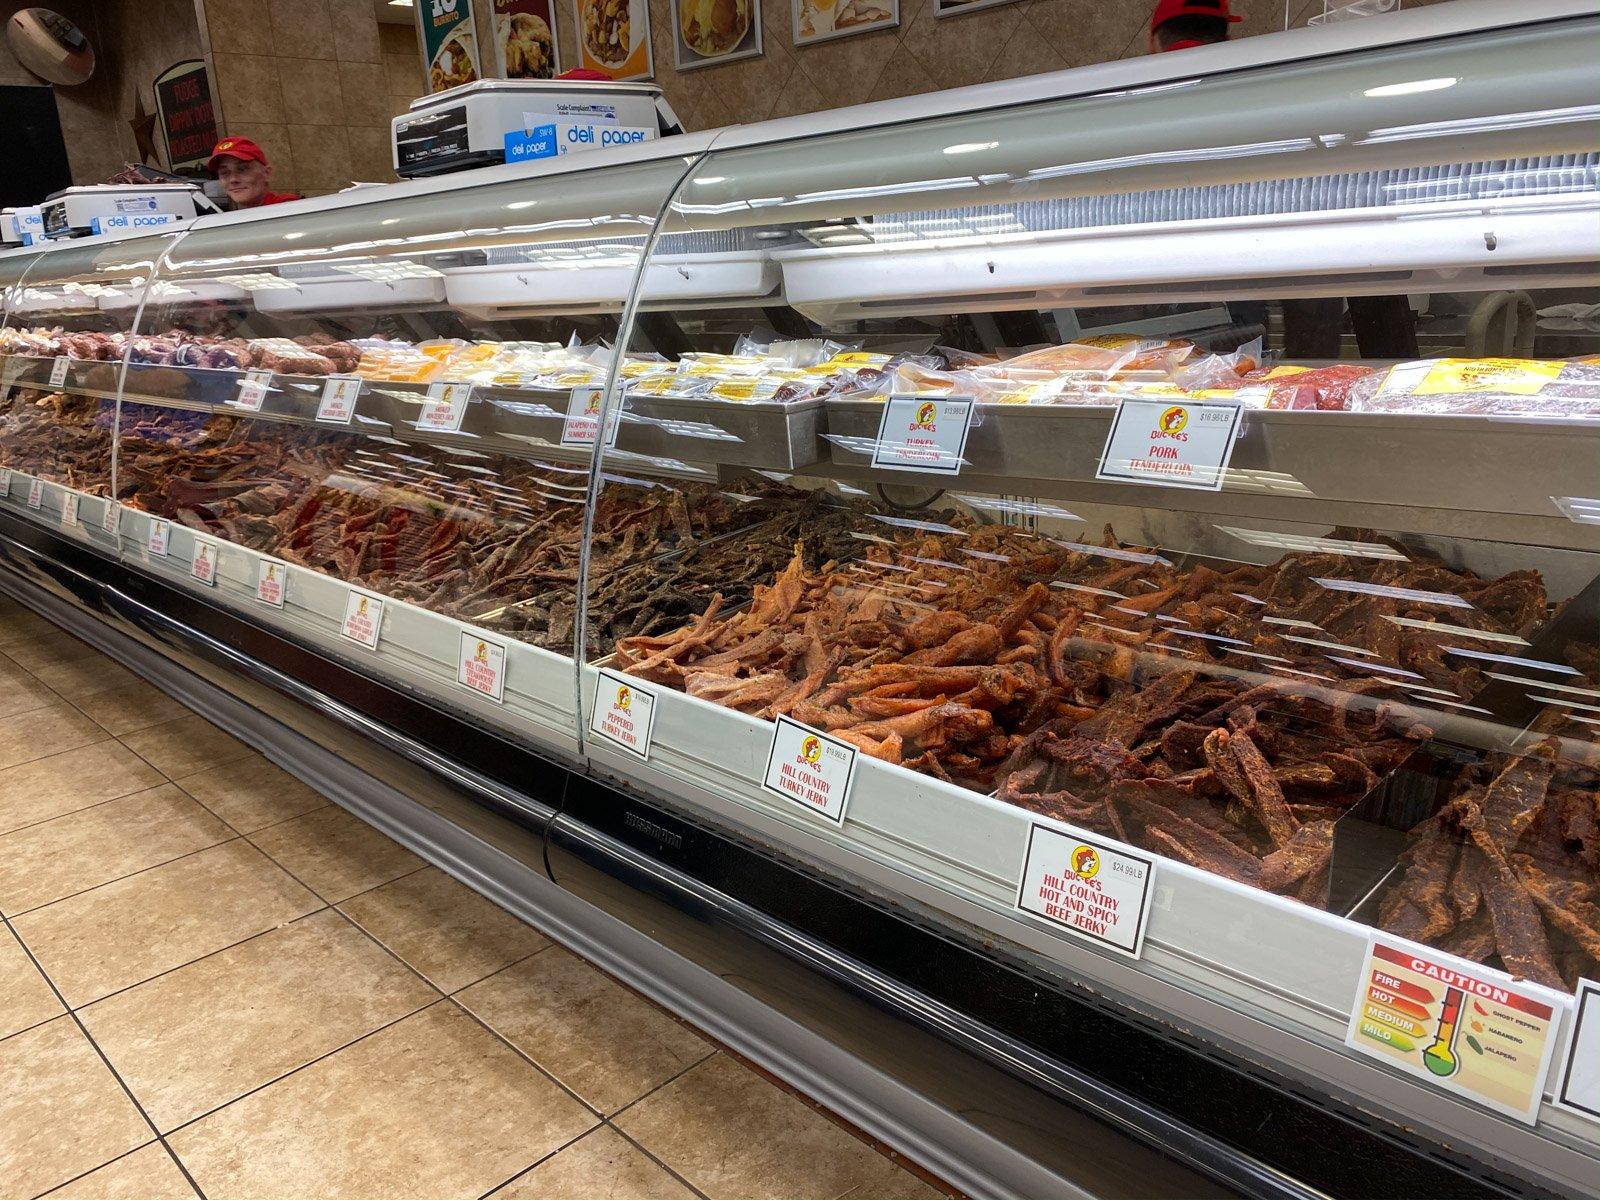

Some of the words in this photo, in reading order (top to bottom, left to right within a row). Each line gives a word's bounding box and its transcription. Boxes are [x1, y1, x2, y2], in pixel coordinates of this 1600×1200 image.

[568, 126, 595, 144] deli
[601, 130, 645, 147] paper
[512, 145, 524, 155] deli
[526, 141, 547, 154] paper
[107, 215, 129, 227] deli
[134, 215, 169, 228] paper
[1148, 445, 1180, 459] PORK
[1129, 458, 1194, 476] TENDERLOIN
[607, 711, 634, 731] PEPPERED
[601, 720, 620, 735] TURKEY
[621, 732, 637, 746] JERKY
[781, 762, 797, 779] HILL
[798, 770, 832, 794] COUNTRY
[779, 775, 805, 798] TURKEY
[805, 788, 829, 808] JERKY
[1043, 874, 1066, 893] HILL
[1069, 884, 1119, 911] COUNTRY
[1039, 886, 1061, 903] HOT
[1062, 896, 1085, 913] AND
[1086, 905, 1119, 926] SPICY
[1045, 902, 1072, 922] BEEF
[1072, 912, 1108, 936] JERKY
[1374, 972, 1401, 990] FIRE
[1410, 958, 1510, 1004] CAUTION
[1371, 989, 1396, 1005] HOT
[1367, 1006, 1414, 1032] MEDIUM
[1492, 1010, 1514, 1023] GHOST
[1515, 1018, 1541, 1033] PEPPER
[1364, 1023, 1392, 1041] MILD
[1488, 1027, 1523, 1045] HABANERO
